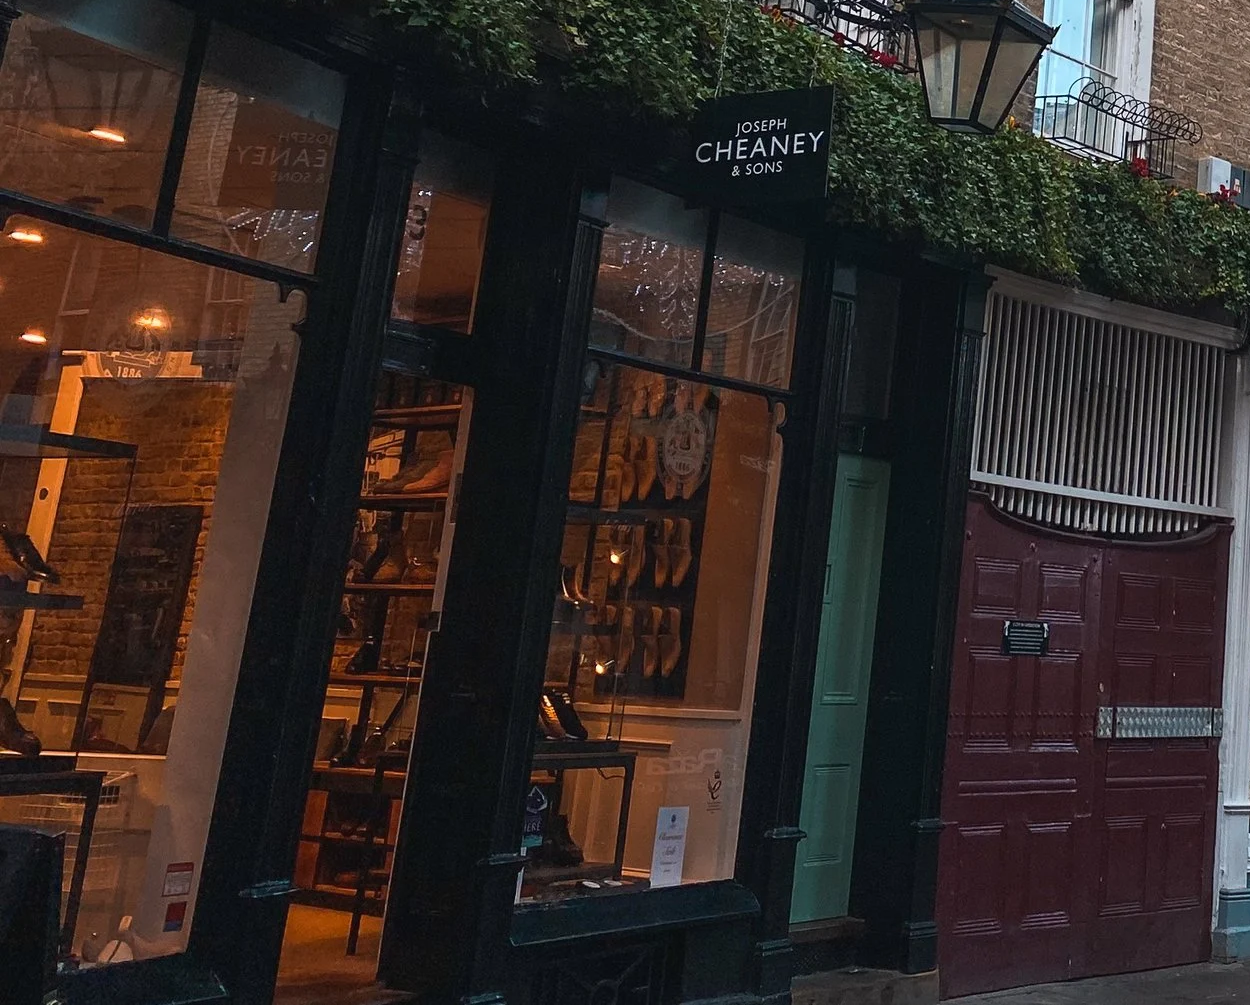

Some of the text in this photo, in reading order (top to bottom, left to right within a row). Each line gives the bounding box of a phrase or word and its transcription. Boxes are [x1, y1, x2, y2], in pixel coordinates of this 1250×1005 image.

[735, 118, 787, 137] JOSEPH
[695, 131, 824, 163] CHEANEY
[731, 161, 783, 176] & SONS
